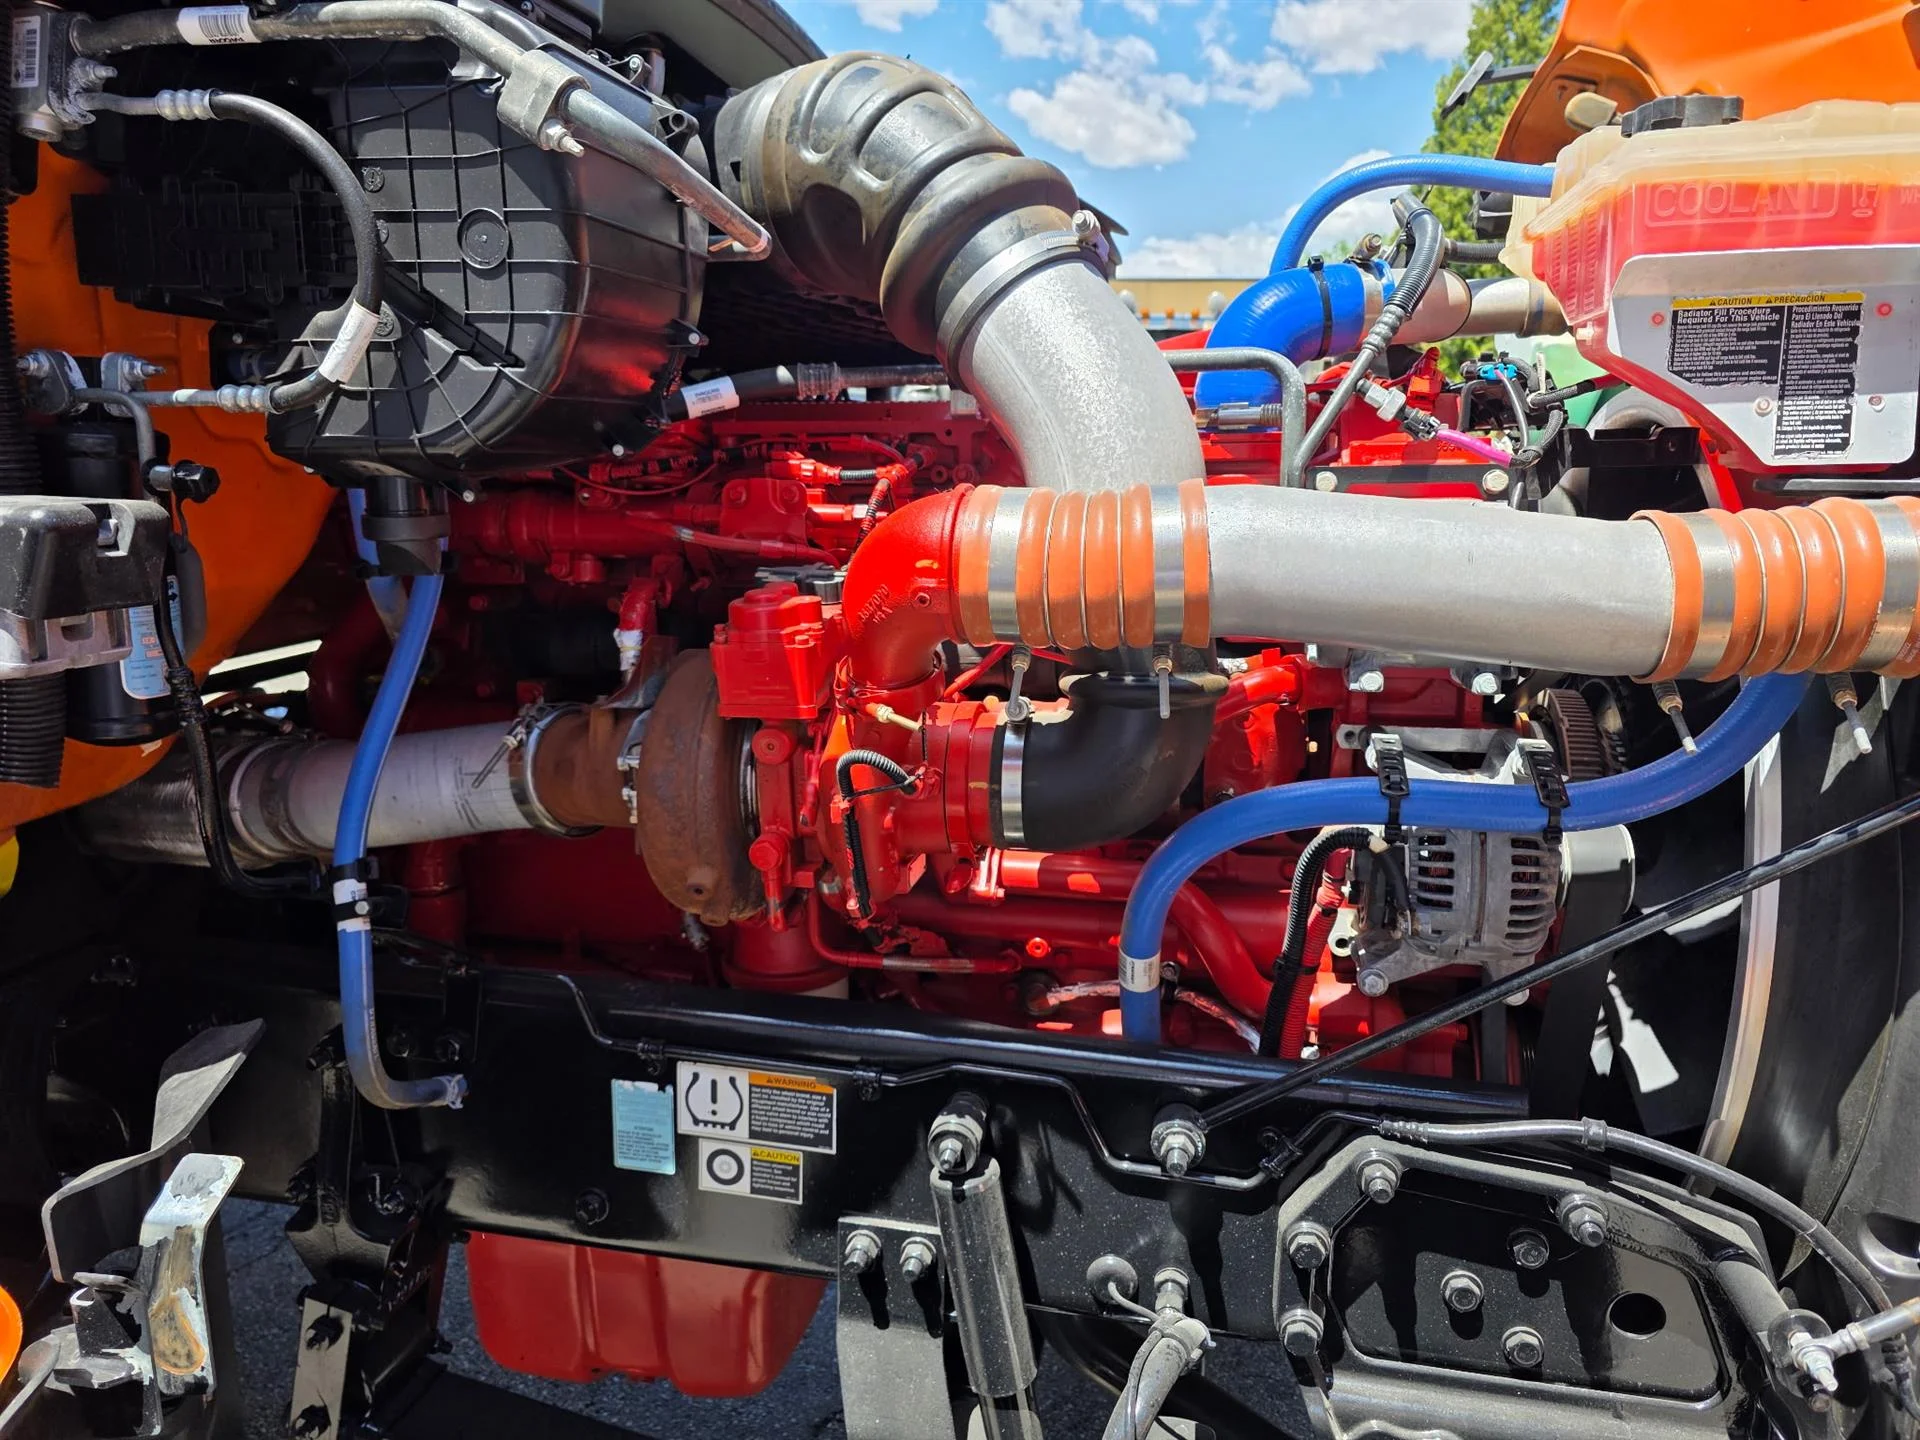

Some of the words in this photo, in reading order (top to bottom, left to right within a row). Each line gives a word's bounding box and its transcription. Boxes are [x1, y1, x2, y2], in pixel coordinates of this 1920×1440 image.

[1653, 177, 1830, 217] COOLANT
[1717, 297, 1752, 306] CAUTION
[1677, 308, 1712, 318] Radiator
[1713, 308, 1726, 316] Fill
[1729, 306, 1770, 316] Procedure
[1677, 315, 1713, 325] Required
[1715, 314, 1727, 322] For
[1730, 314, 1747, 322] This
[1750, 312, 1780, 321] Vehicle
[774, 1079, 816, 1090] WARNING
[759, 1150, 799, 1162] CAUTION
